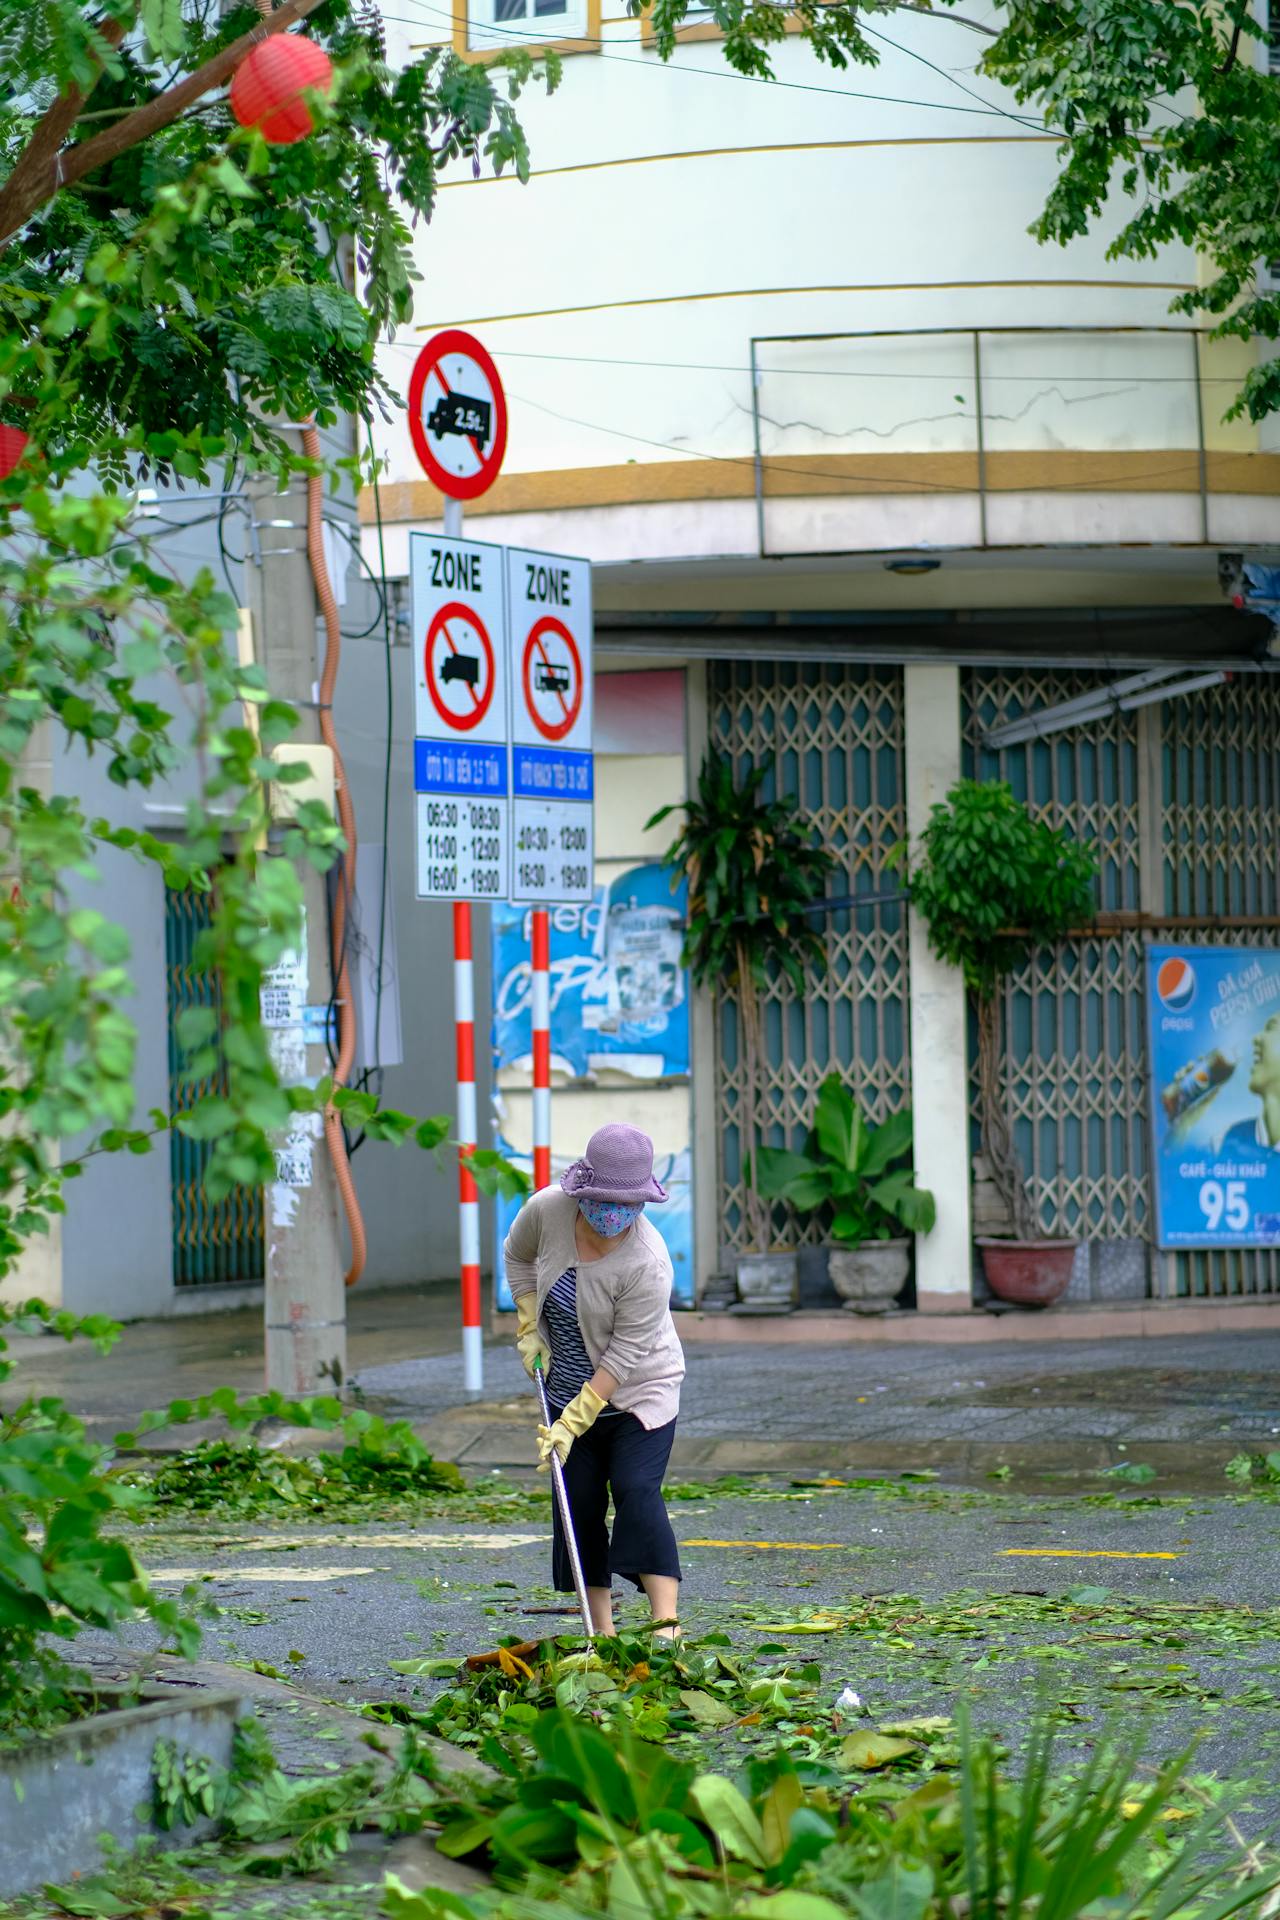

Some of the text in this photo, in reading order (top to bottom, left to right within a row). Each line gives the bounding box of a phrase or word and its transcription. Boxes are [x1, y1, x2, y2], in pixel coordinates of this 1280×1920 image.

[430, 549, 482, 593] ZONE
[526, 564, 571, 606] ZONE
[427, 802, 457, 828] 06:30
[470, 806, 500, 831] 08:30
[427, 834, 457, 860] 11:00
[471, 837, 500, 861] 12:00
[519, 827, 548, 851] 10:30
[560, 826, 587, 851] 12:00
[427, 866, 457, 892] 16:00
[471, 869, 500, 893] 19:00
[561, 864, 587, 889] 19:00
[1199, 1180, 1249, 1231] 95
